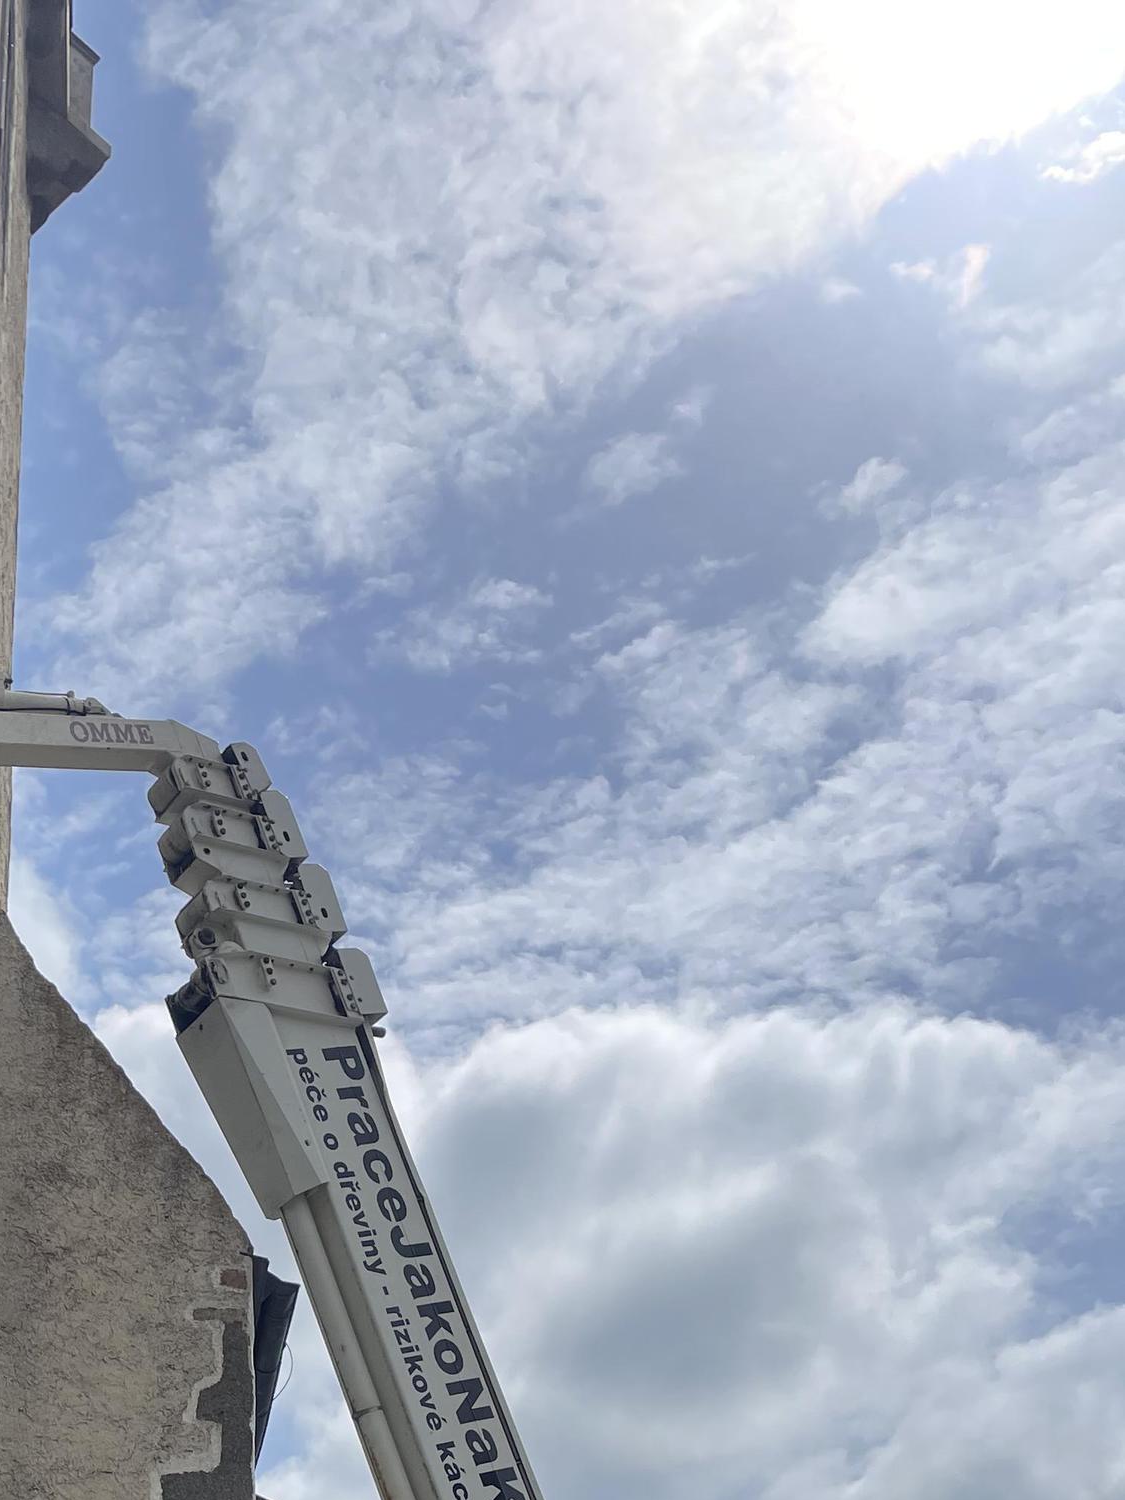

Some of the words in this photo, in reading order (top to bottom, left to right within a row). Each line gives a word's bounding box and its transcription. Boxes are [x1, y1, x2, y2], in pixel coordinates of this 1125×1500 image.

[69, 721, 154, 744] OMME
[286, 1048, 328, 1122] péče
[323, 1132, 339, 1151] o
[333, 1161, 387, 1276] dřeviny
[385, 1306, 448, 1431] rizikové
